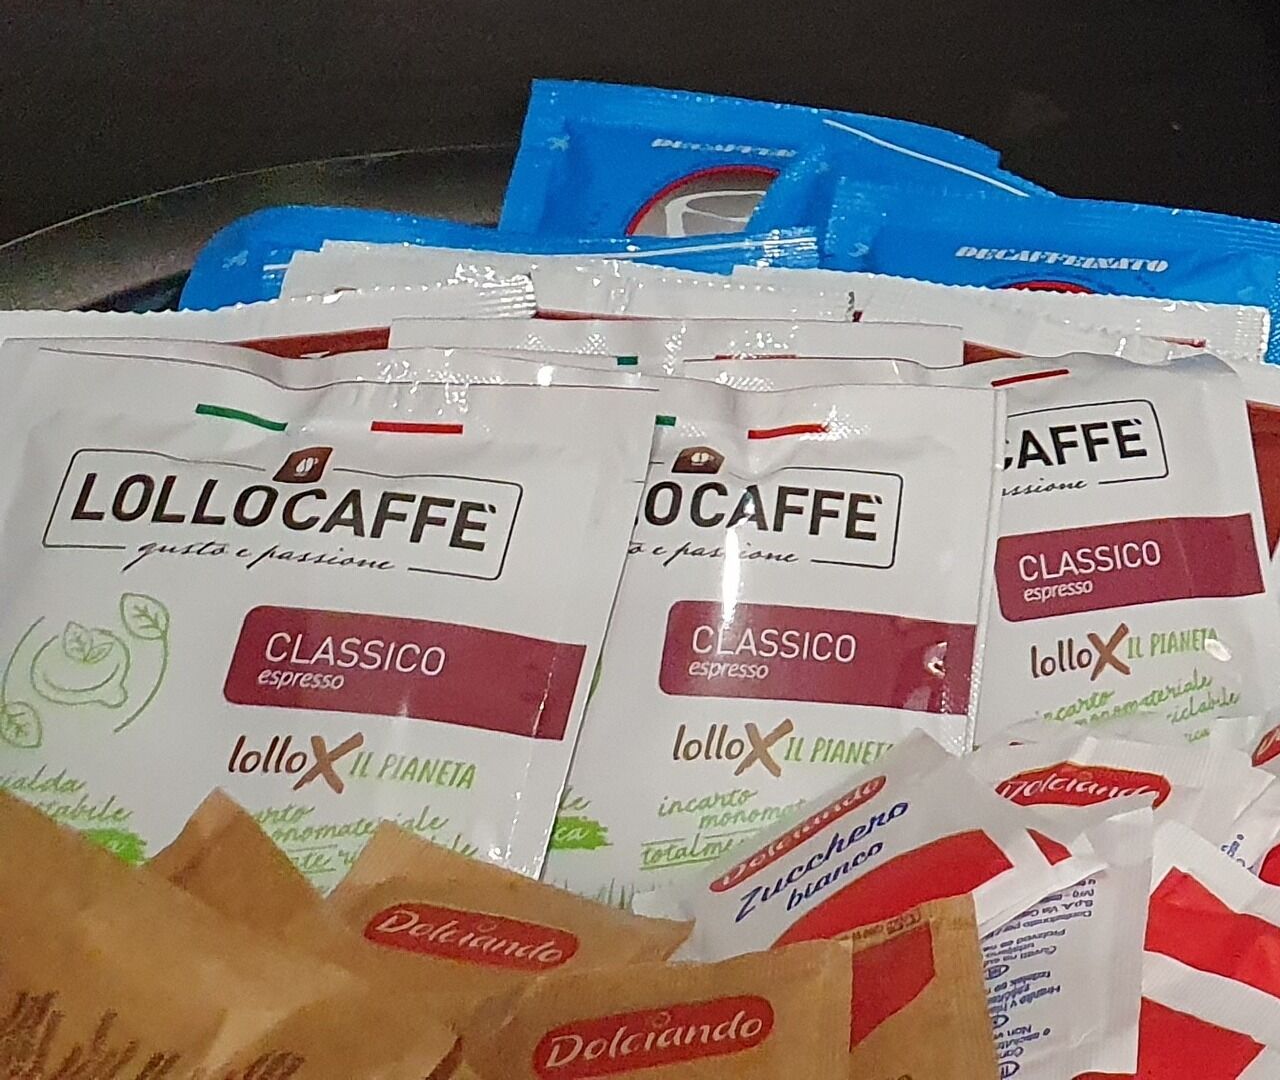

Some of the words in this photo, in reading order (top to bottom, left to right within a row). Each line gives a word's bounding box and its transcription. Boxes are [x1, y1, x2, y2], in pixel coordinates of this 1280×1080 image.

[121, 540, 225, 573] gusto
[246, 542, 396, 572] passione
[1017, 539, 1163, 583] CLASSICO
[1022, 578, 1094, 604] espresso
[264, 631, 448, 676] CLASSICO
[690, 624, 858, 664] CLASSICO
[256, 668, 345, 691] espresso
[687, 657, 770, 682] espresso
[376, 752, 478, 790] PIANETA
[657, 787, 760, 818] incarto
[733, 801, 911, 923] Zucchero
[784, 841, 884, 914] bianco
[374, 908, 567, 966] Dolciando
[544, 1009, 766, 1071] Dolciando
